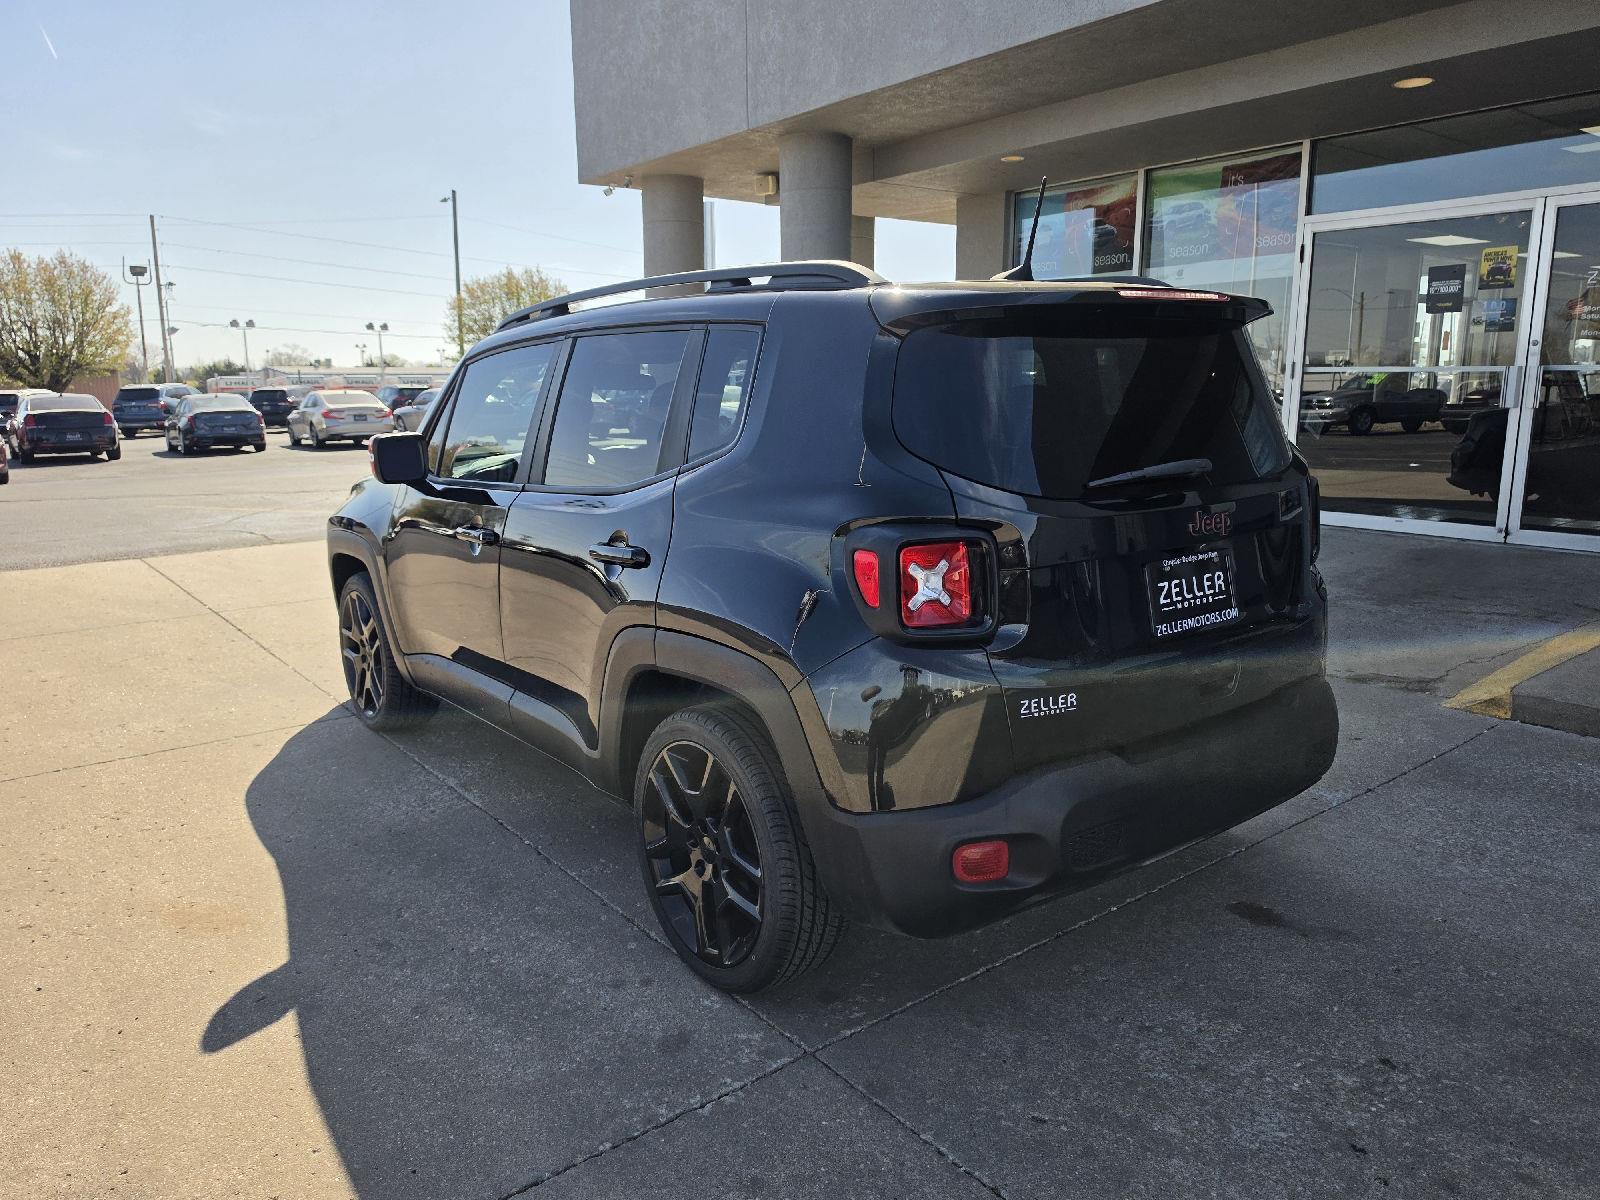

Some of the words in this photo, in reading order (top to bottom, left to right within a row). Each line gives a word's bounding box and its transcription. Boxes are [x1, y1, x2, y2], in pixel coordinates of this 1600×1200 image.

[1188, 511, 1232, 536] Jeep
[1157, 571, 1226, 605] ZELLER
[1177, 595, 1213, 609] MOTORS
[1156, 607, 1239, 637] ZELLERMOTORS.COM
[1020, 692, 1077, 714] ZELLER
[1034, 707, 1065, 717] MOTORS
